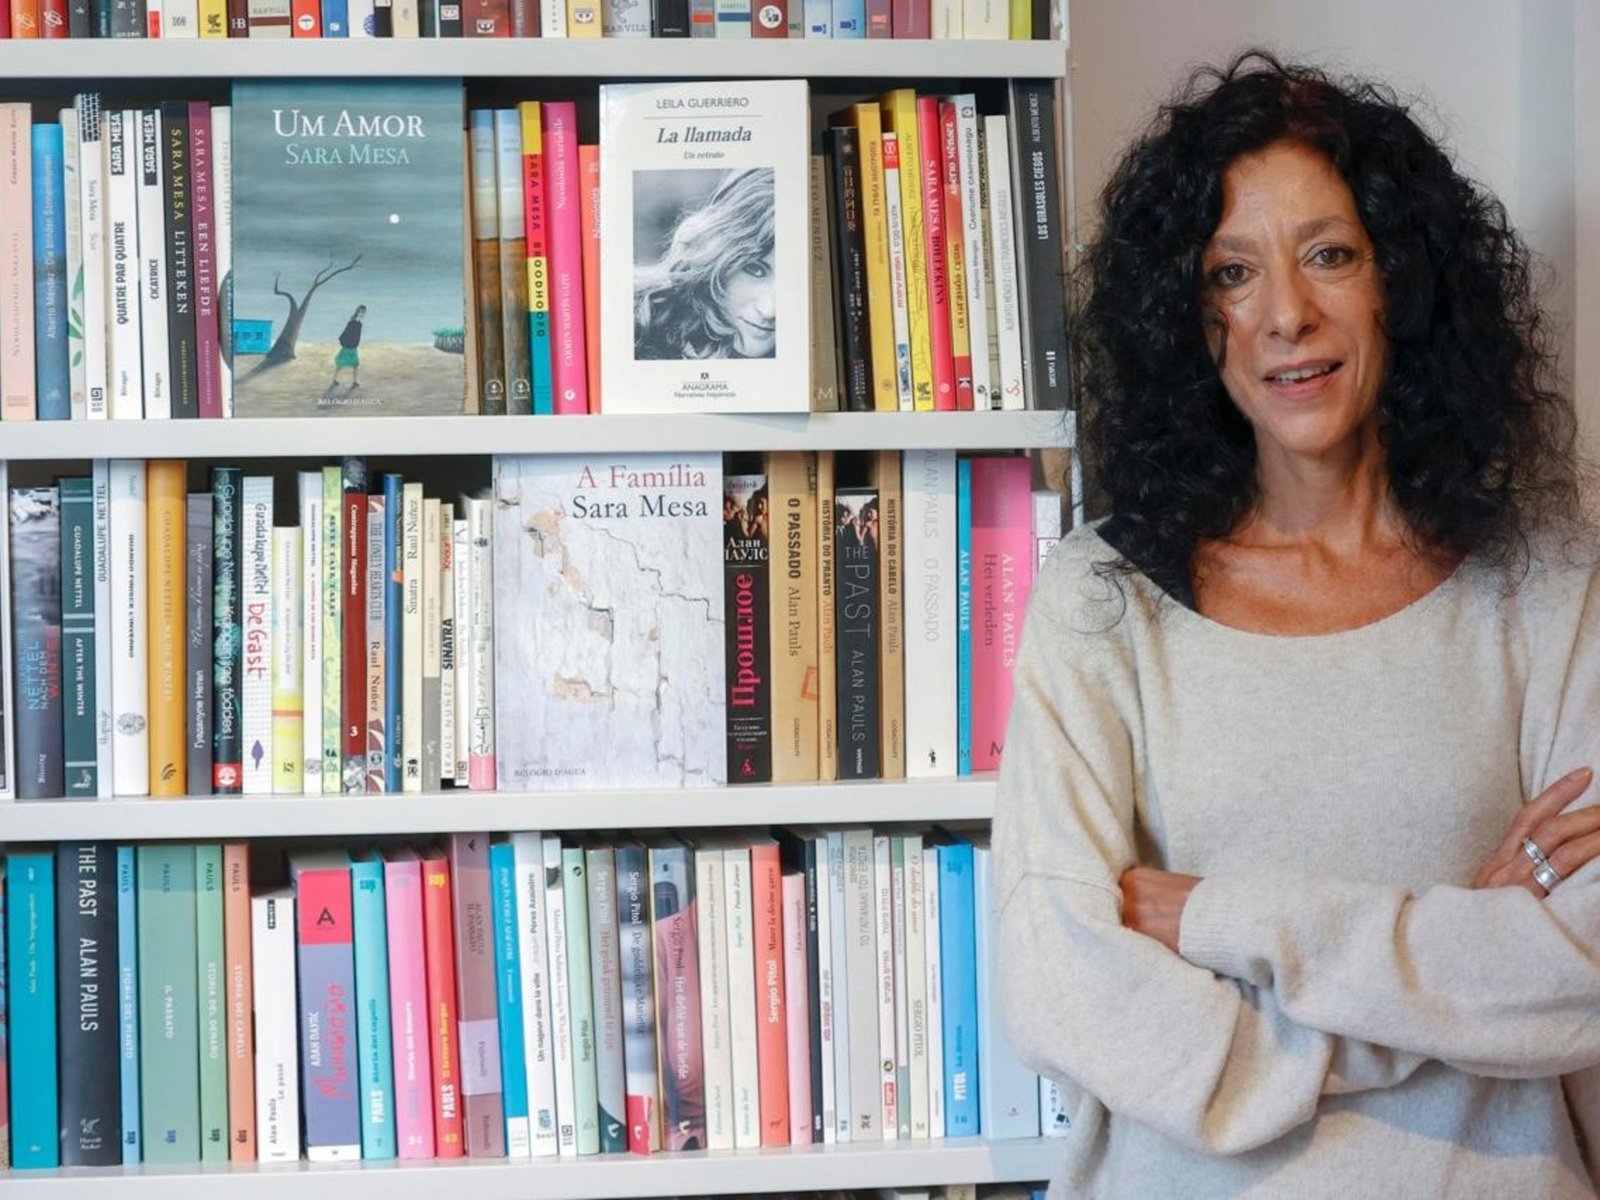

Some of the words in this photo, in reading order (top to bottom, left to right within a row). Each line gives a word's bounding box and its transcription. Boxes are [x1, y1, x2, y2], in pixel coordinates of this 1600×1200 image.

[656, 98, 685, 110] LEILA
[687, 96, 750, 109] GUERRIERO
[110, 113, 121, 142] MESA
[143, 113, 155, 142] MESA
[656, 126, 679, 144] La
[683, 125, 753, 143] llamada
[112, 143, 123, 174] SARA
[144, 143, 156, 173] SARA
[171, 128, 183, 170] SARA
[194, 128, 205, 167] SARA
[529, 153, 541, 187] SARA
[926, 160, 937, 195] SARA
[1031, 151, 1044, 180] CIEGOS
[173, 176, 184, 221] MESA
[196, 172, 207, 213] MESA
[1033, 180, 1048, 224] GIRASOLES
[531, 194, 541, 231] MESA
[928, 200, 939, 234] MESA
[112, 221, 127, 261] QUATRE
[197, 223, 209, 252] EEN
[1036, 224, 1049, 240] LOS
[114, 262, 127, 283] PAR
[149, 259, 160, 300] CICATRICE
[174, 230, 188, 314] LITTEKEN
[199, 258, 212, 316] LIEFDE
[115, 285, 129, 325] QUATRE
[533, 241, 546, 338] BROODHOOFD
[681, 383, 729, 391] ANAGRAMA
[576, 464, 598, 489] A
[608, 463, 707, 489] Família
[924, 451, 939, 488] ALAN
[96, 484, 107, 521] NETTEL
[572, 494, 629, 519] Sara
[638, 494, 709, 518] Mesa
[788, 497, 801, 508] O
[924, 494, 939, 539] PAULS
[219, 483, 236, 561] Guadalupe
[251, 502, 268, 563] Guadalupe
[370, 522, 383, 537] THE
[821, 500, 831, 542] HISTÓRIA
[887, 498, 897, 542] HISTÓRIA
[74, 525, 82, 575] GUADALUPE
[97, 525, 107, 582] GUADALUPE
[370, 539, 383, 569] LONELY
[726, 536, 761, 549] Алан
[788, 512, 801, 580] PASSADO
[822, 544, 831, 557] DO
[845, 545, 869, 559] THE
[888, 543, 897, 557] DO
[822, 559, 833, 596] PRANTO
[888, 559, 897, 595] CABELO
[924, 557, 939, 568] O
[959, 550, 971, 588] ALAN
[984, 553, 997, 581] Het
[1002, 552, 1014, 604] ALAN
[74, 578, 82, 608] NETTEL
[370, 570, 383, 601] HEARTS
[407, 578, 418, 615] Sinatra
[788, 586, 801, 617] Alan
[844, 563, 870, 639] PAST
[247, 603, 265, 626] De
[924, 574, 940, 642] PASSADO
[960, 591, 971, 632] PAULS
[984, 585, 998, 646] verleden
[74, 637, 83, 664] AFTER
[442, 618, 453, 671] SINATRA
[731, 573, 762, 707] Прошлое
[788, 620, 801, 657] Pauls
[1003, 611, 1015, 667] PAULS
[39, 651, 48, 675] DEM
[247, 629, 268, 681] Gast
[851, 650, 866, 688] ALAN
[26, 641, 41, 711] NETTEL
[75, 664, 84, 681] THE
[40, 678, 49, 710] NACH
[76, 683, 85, 716] WINTER
[221, 687, 235, 735] föddes
[852, 694, 867, 742] PAULS
[350, 725, 358, 738] 3
[78, 845, 96, 873] THE
[121, 863, 129, 893] PAULS
[162, 863, 171, 893] PAULS
[206, 862, 215, 892] PAULS
[232, 863, 241, 893] PAULS
[628, 871, 641, 902] Sergio
[79, 879, 97, 917] PAST
[630, 903, 641, 925] Pitol
[766, 890, 776, 916] divine
[767, 917, 775, 926] la
[632, 932, 643, 945] De
[766, 927, 777, 952] Mater
[80, 937, 98, 978] ALAN
[632, 946, 646, 995] goddelijke
[673, 948, 685, 969] Pitol
[766, 960, 778, 986] Pitol
[123, 967, 132, 1001] STORIA
[208, 962, 217, 996] STORIA
[234, 965, 243, 998] STORIA
[532, 972, 541, 988] ville
[533, 989, 541, 998] la
[675, 976, 686, 993] Het
[81, 984, 99, 1031] PAULS
[124, 1003, 133, 1021] DEL
[165, 997, 175, 1039] PASSATO
[209, 999, 218, 1017] DEL
[533, 997, 543, 1019] dans
[767, 988, 780, 1025] Sergio
[125, 1023, 134, 1059] PIANTO
[535, 1020, 545, 1049] nageur
[677, 1021, 686, 1038] van
[678, 1039, 688, 1051] de
[536, 1049, 545, 1062] Un
[678, 1052, 690, 1080] liefde
[443, 1083, 457, 1120] PAULS
[952, 1071, 967, 1101] PITOL
[369, 1089, 384, 1124] PAULS
[268, 1125, 277, 1145] Alan
